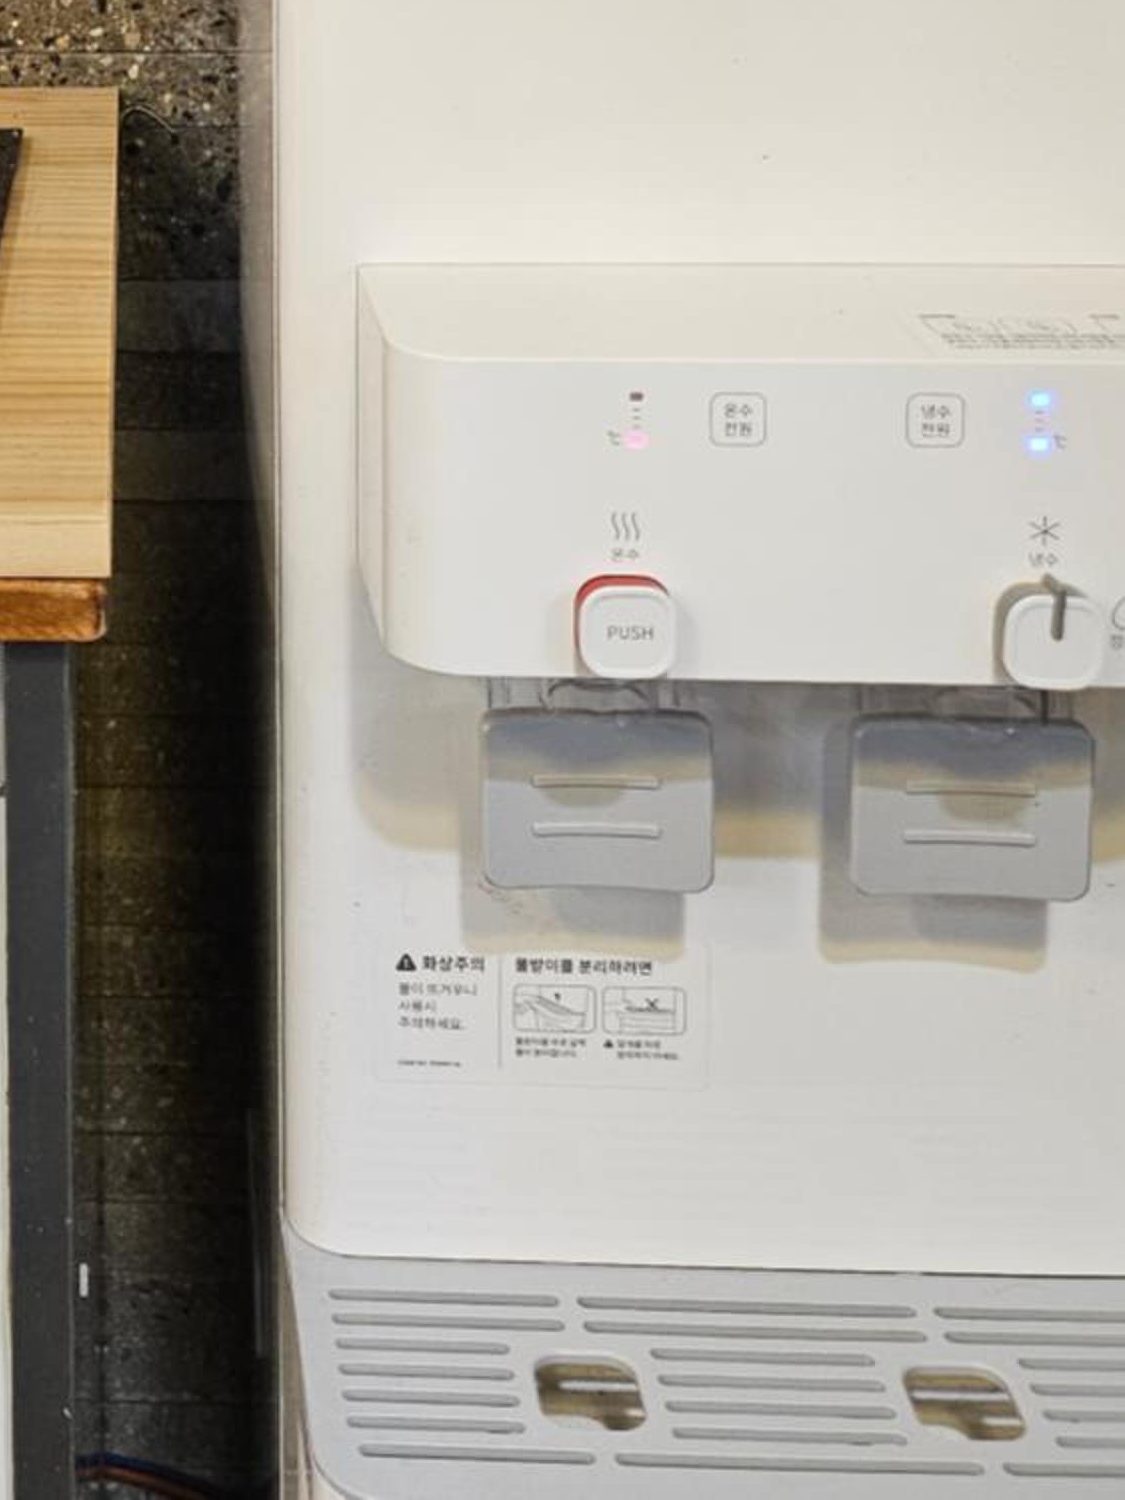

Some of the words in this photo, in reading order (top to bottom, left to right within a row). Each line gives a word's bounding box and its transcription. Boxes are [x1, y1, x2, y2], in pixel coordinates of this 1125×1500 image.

[724, 403, 754, 418] 온수
[921, 404, 951, 419] 냉수
[725, 422, 753, 437] 전원
[610, 548, 641, 562] 온수
[1027, 553, 1059, 567] 냉수
[606, 626, 654, 641] PUSH
[422, 955, 486, 973] 화상주의
[516, 957, 573, 974] 물받이를
[578, 959, 653, 976] 분리하려면
